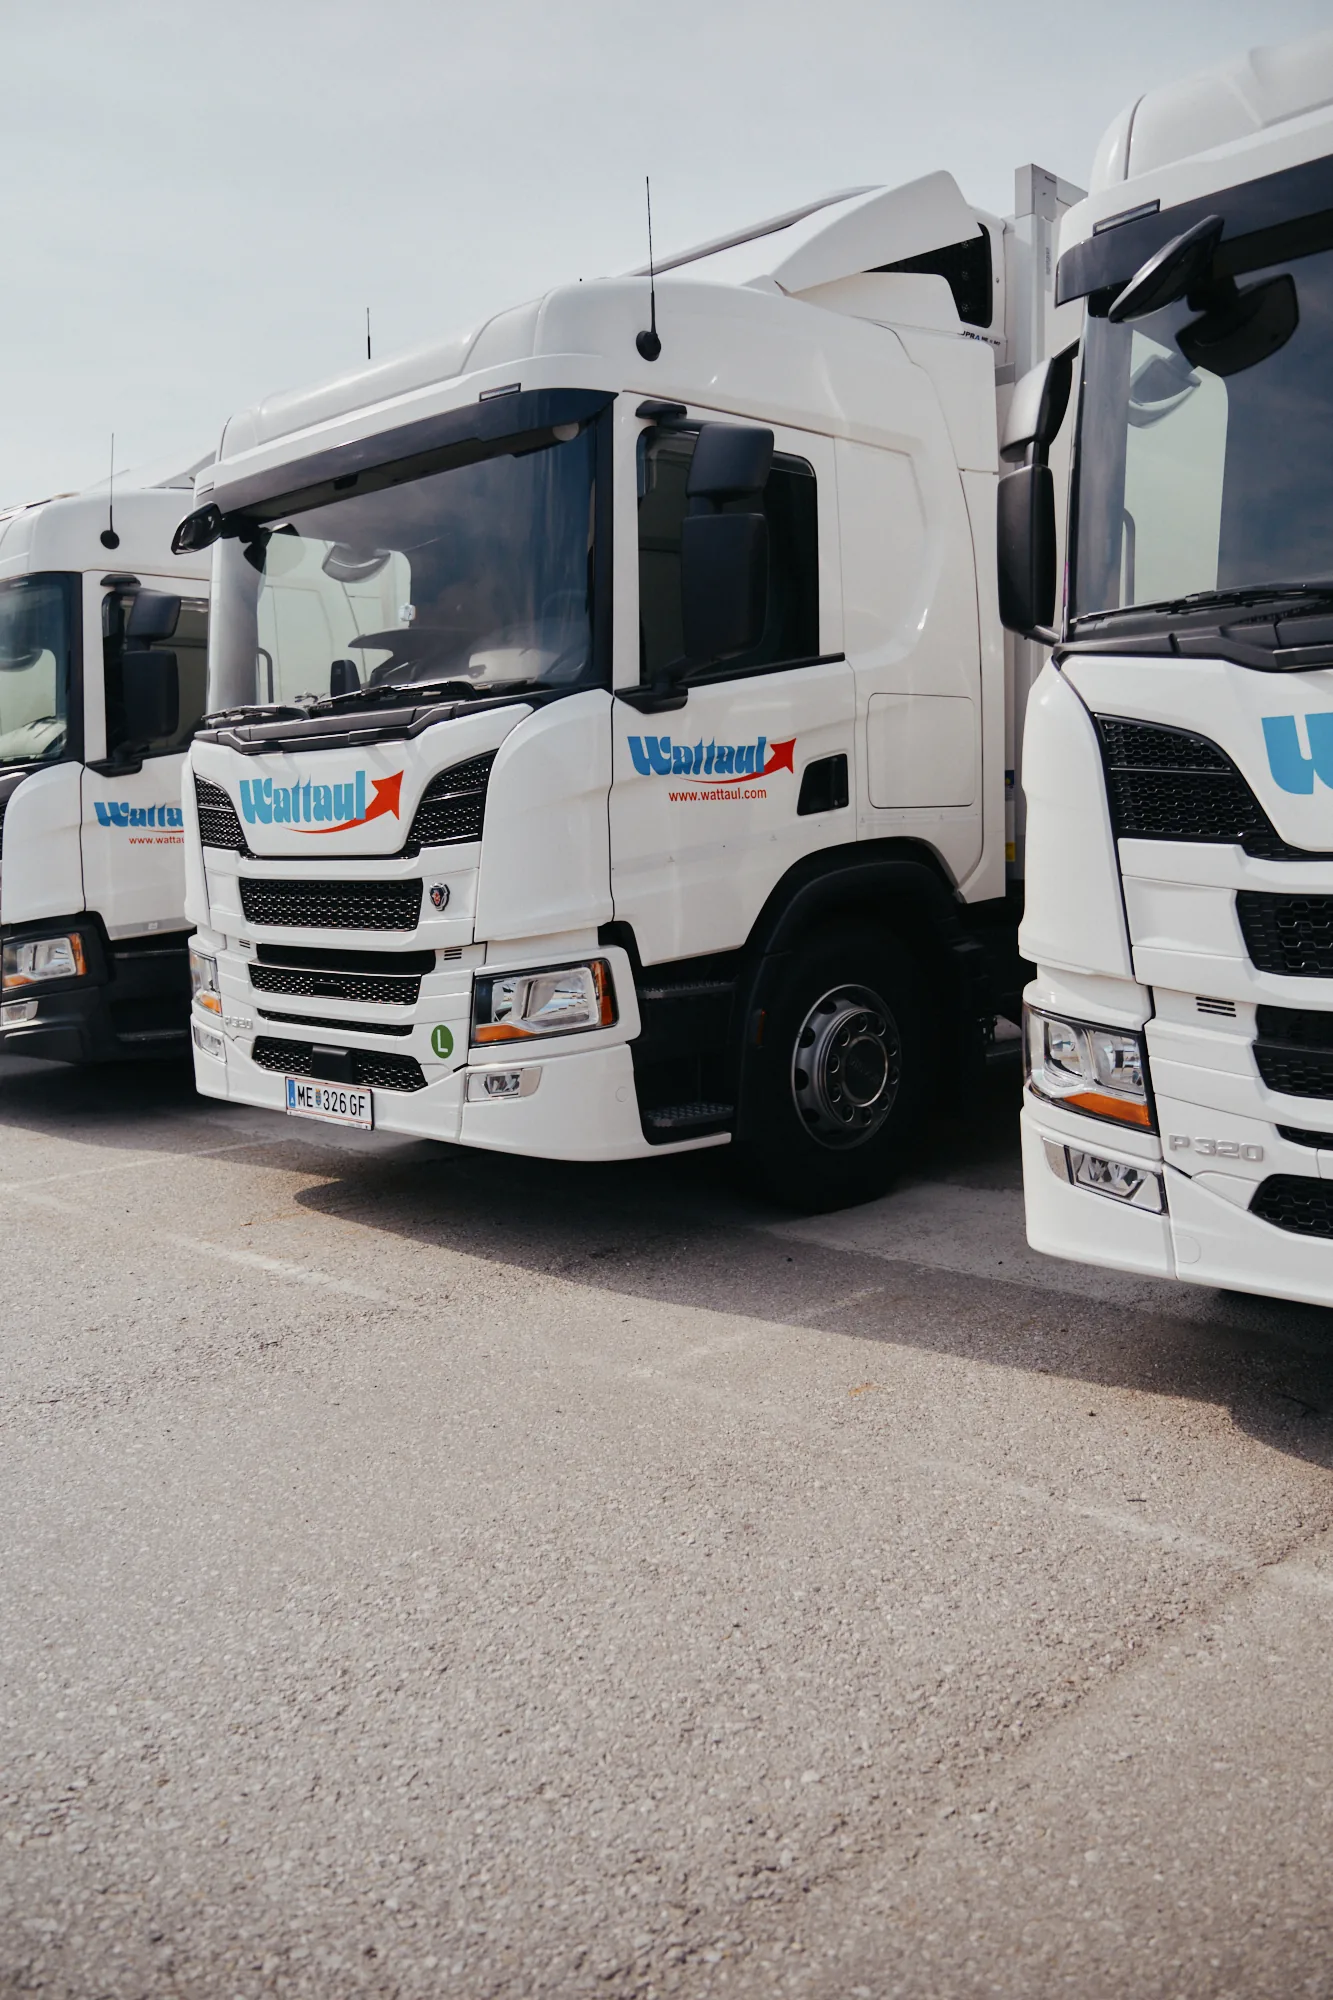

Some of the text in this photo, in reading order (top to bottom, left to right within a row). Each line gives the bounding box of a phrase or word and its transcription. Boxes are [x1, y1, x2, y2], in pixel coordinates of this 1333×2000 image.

[627, 736, 767, 776] Wattaul
[239, 770, 366, 824] Wattaul
[668, 787, 767, 801] www.wattaul.com
[437, 1029, 449, 1053] L
[298, 1085, 313, 1107] ME
[1168, 1133, 1264, 1162] P 320
